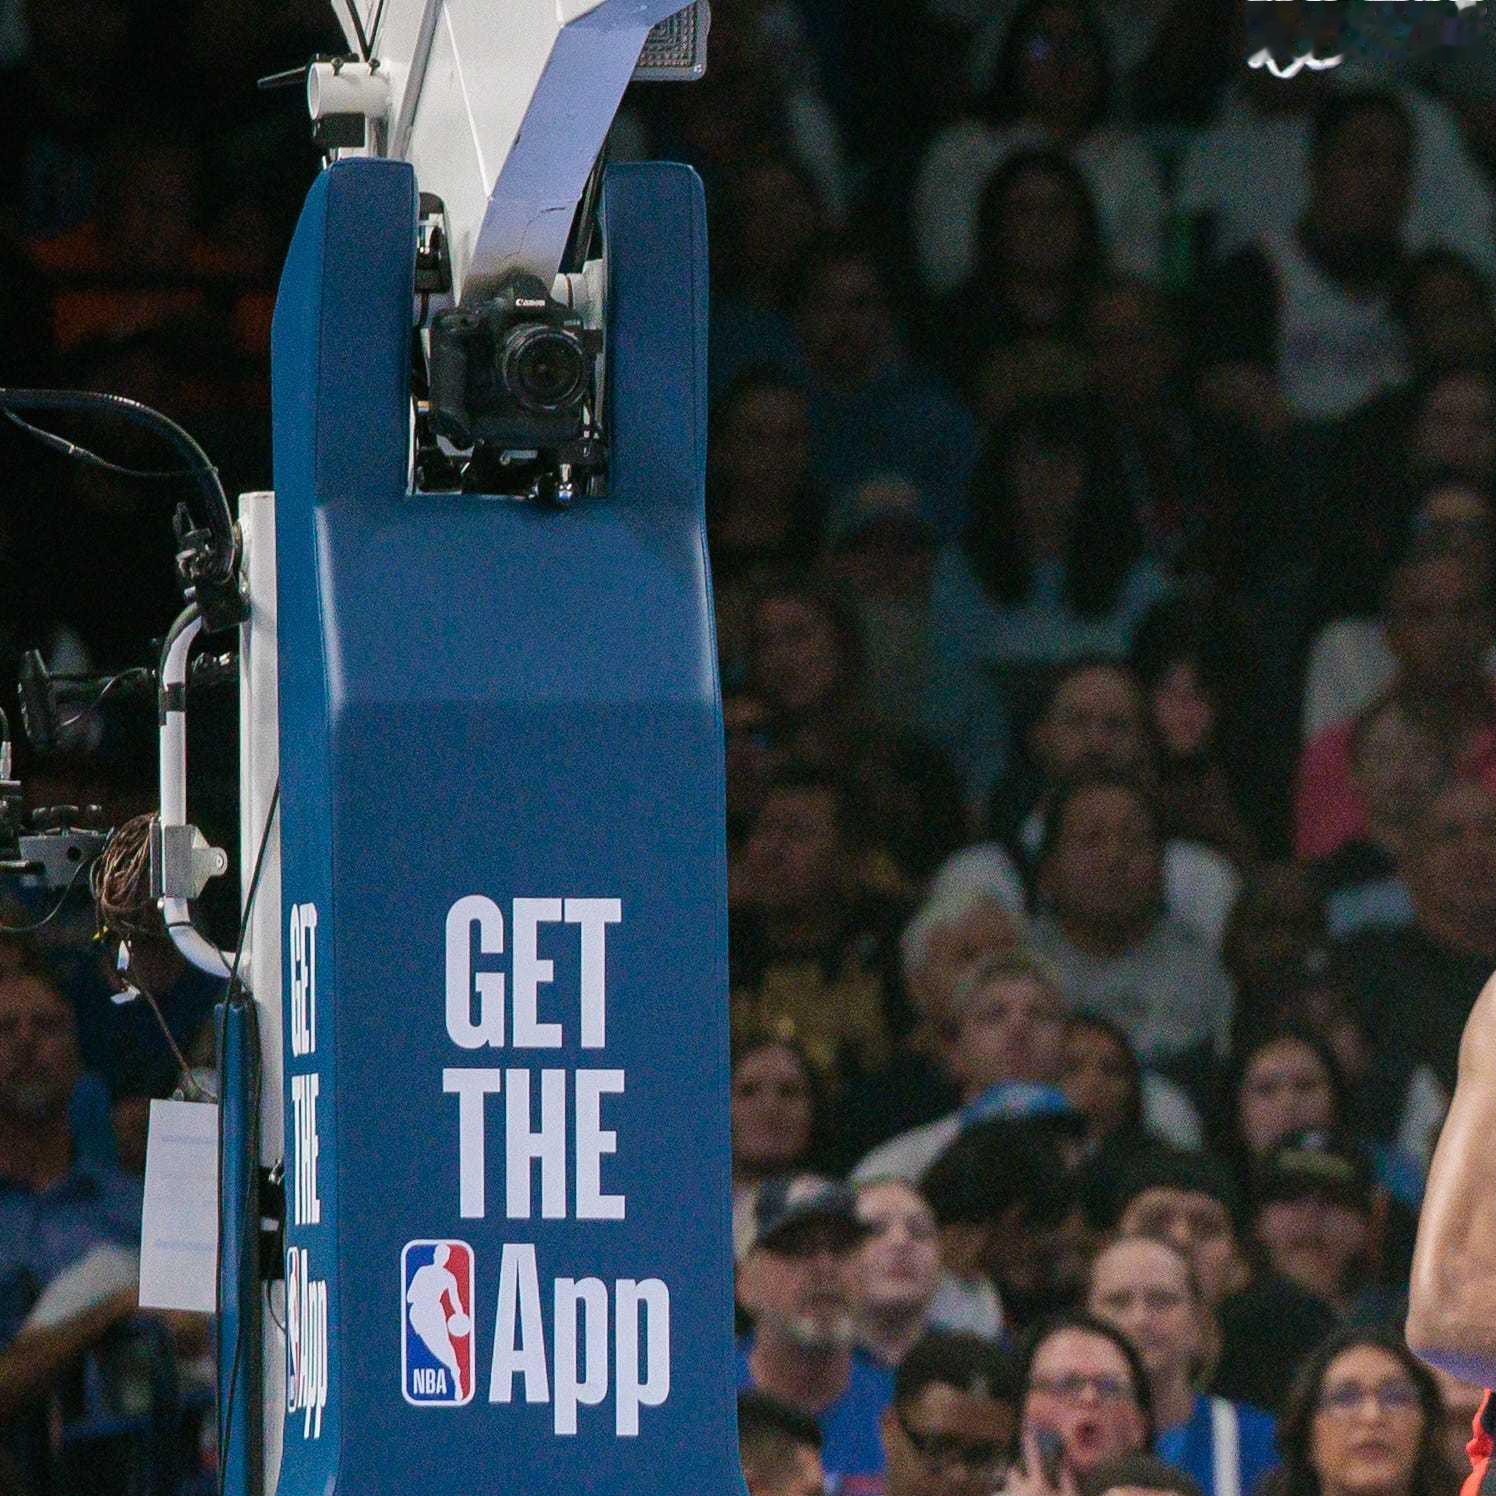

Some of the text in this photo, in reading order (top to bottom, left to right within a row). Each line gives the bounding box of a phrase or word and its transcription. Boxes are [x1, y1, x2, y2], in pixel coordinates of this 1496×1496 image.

[290, 903, 318, 1057] GET
[445, 895, 622, 1049] GET
[291, 1073, 321, 1225] THE
[442, 1068, 626, 1219] THE
[298, 1248, 328, 1440] App
[413, 1368, 447, 1395] NBA
[489, 1243, 670, 1436] App
